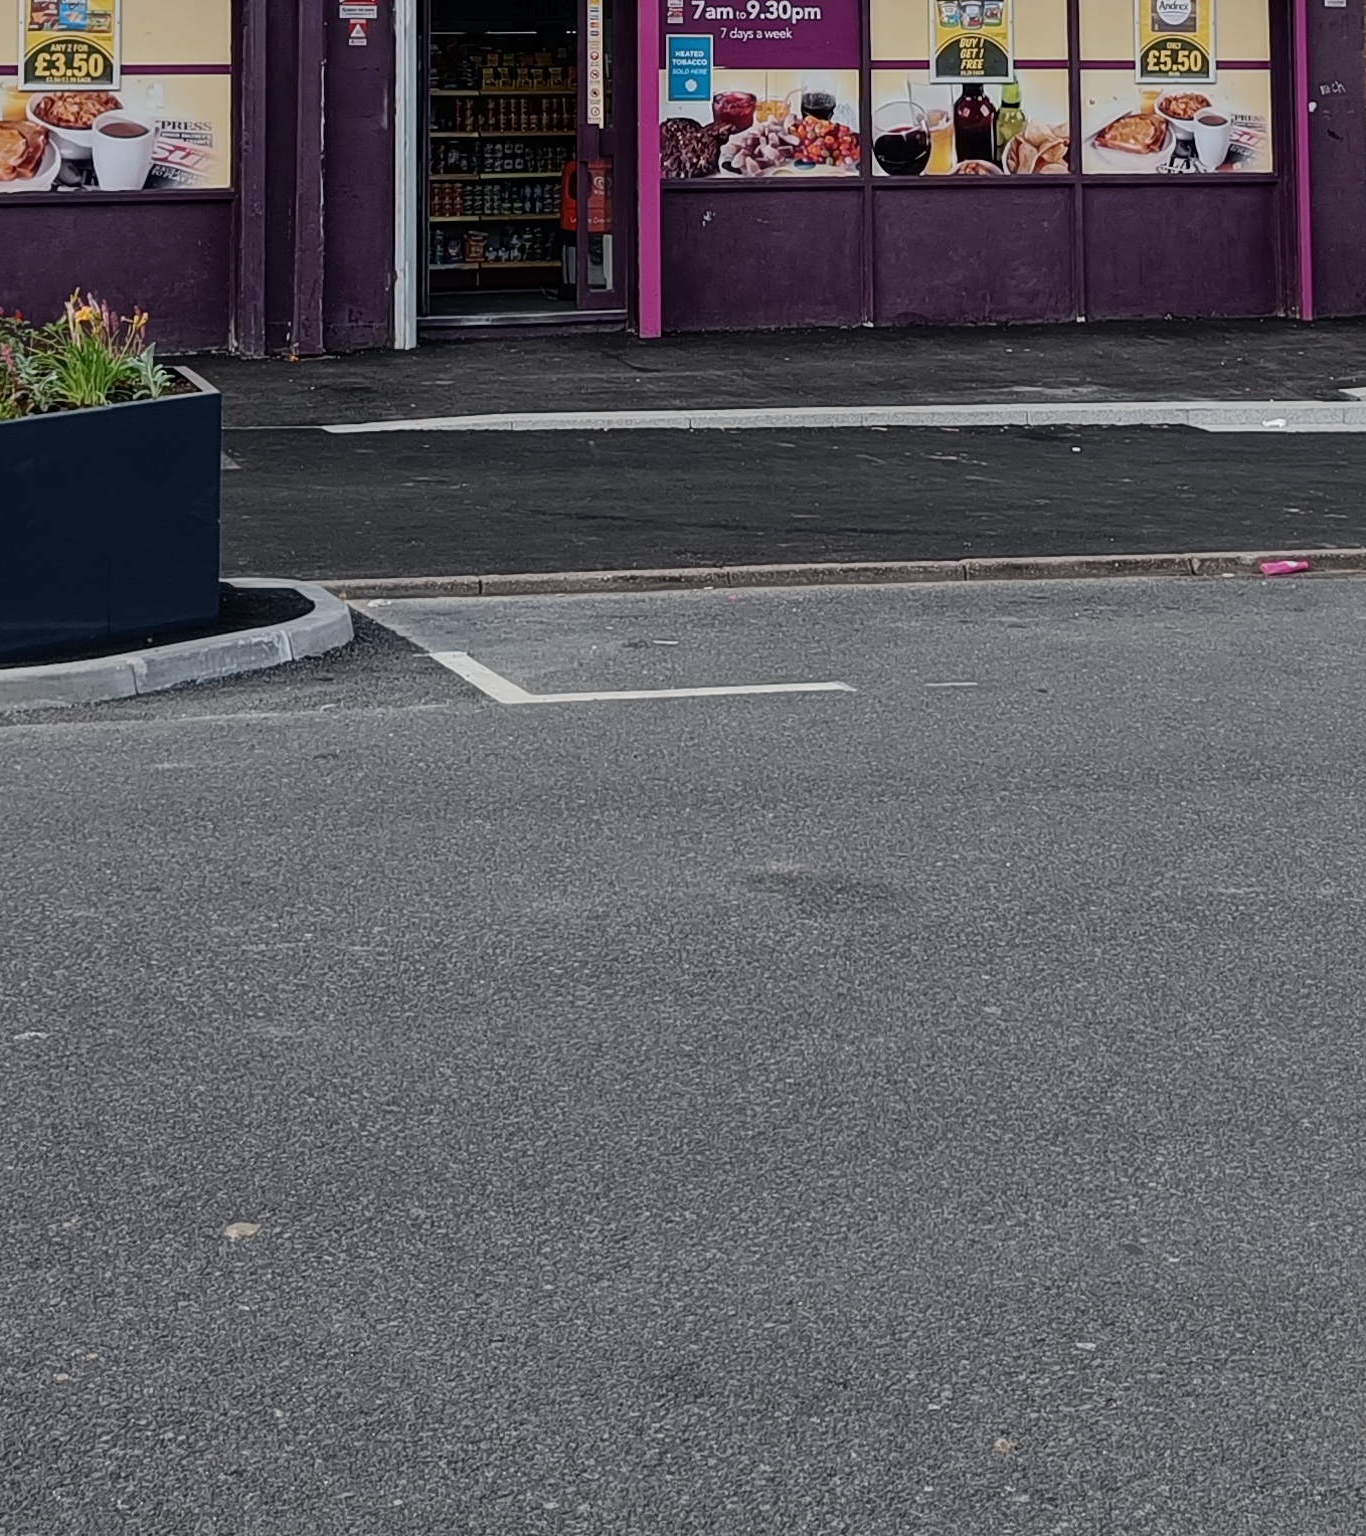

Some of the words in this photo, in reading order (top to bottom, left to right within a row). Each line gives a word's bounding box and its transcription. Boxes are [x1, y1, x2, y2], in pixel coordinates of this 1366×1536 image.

[691, 0, 734, 20] 7am
[736, 10, 746, 20] to
[746, 0, 822, 24] 9.30pm
[1159, 1, 1189, 11] Andrex
[720, 28, 727, 38] 7
[729, 27, 754, 42] days
[756, 30, 762, 38] a
[764, 28, 793, 39] week
[50, 44, 66, 52] ANY
[67, 44, 72, 52] 2
[73, 44, 88, 52] FOR
[959, 37, 979, 48] BUY
[960, 48, 978, 59] GET
[35, 53, 104, 77] £3.50
[960, 59, 984, 70] FREE
[1147, 50, 1202, 72] £5.50
[158, 119, 212, 132] PRESS
